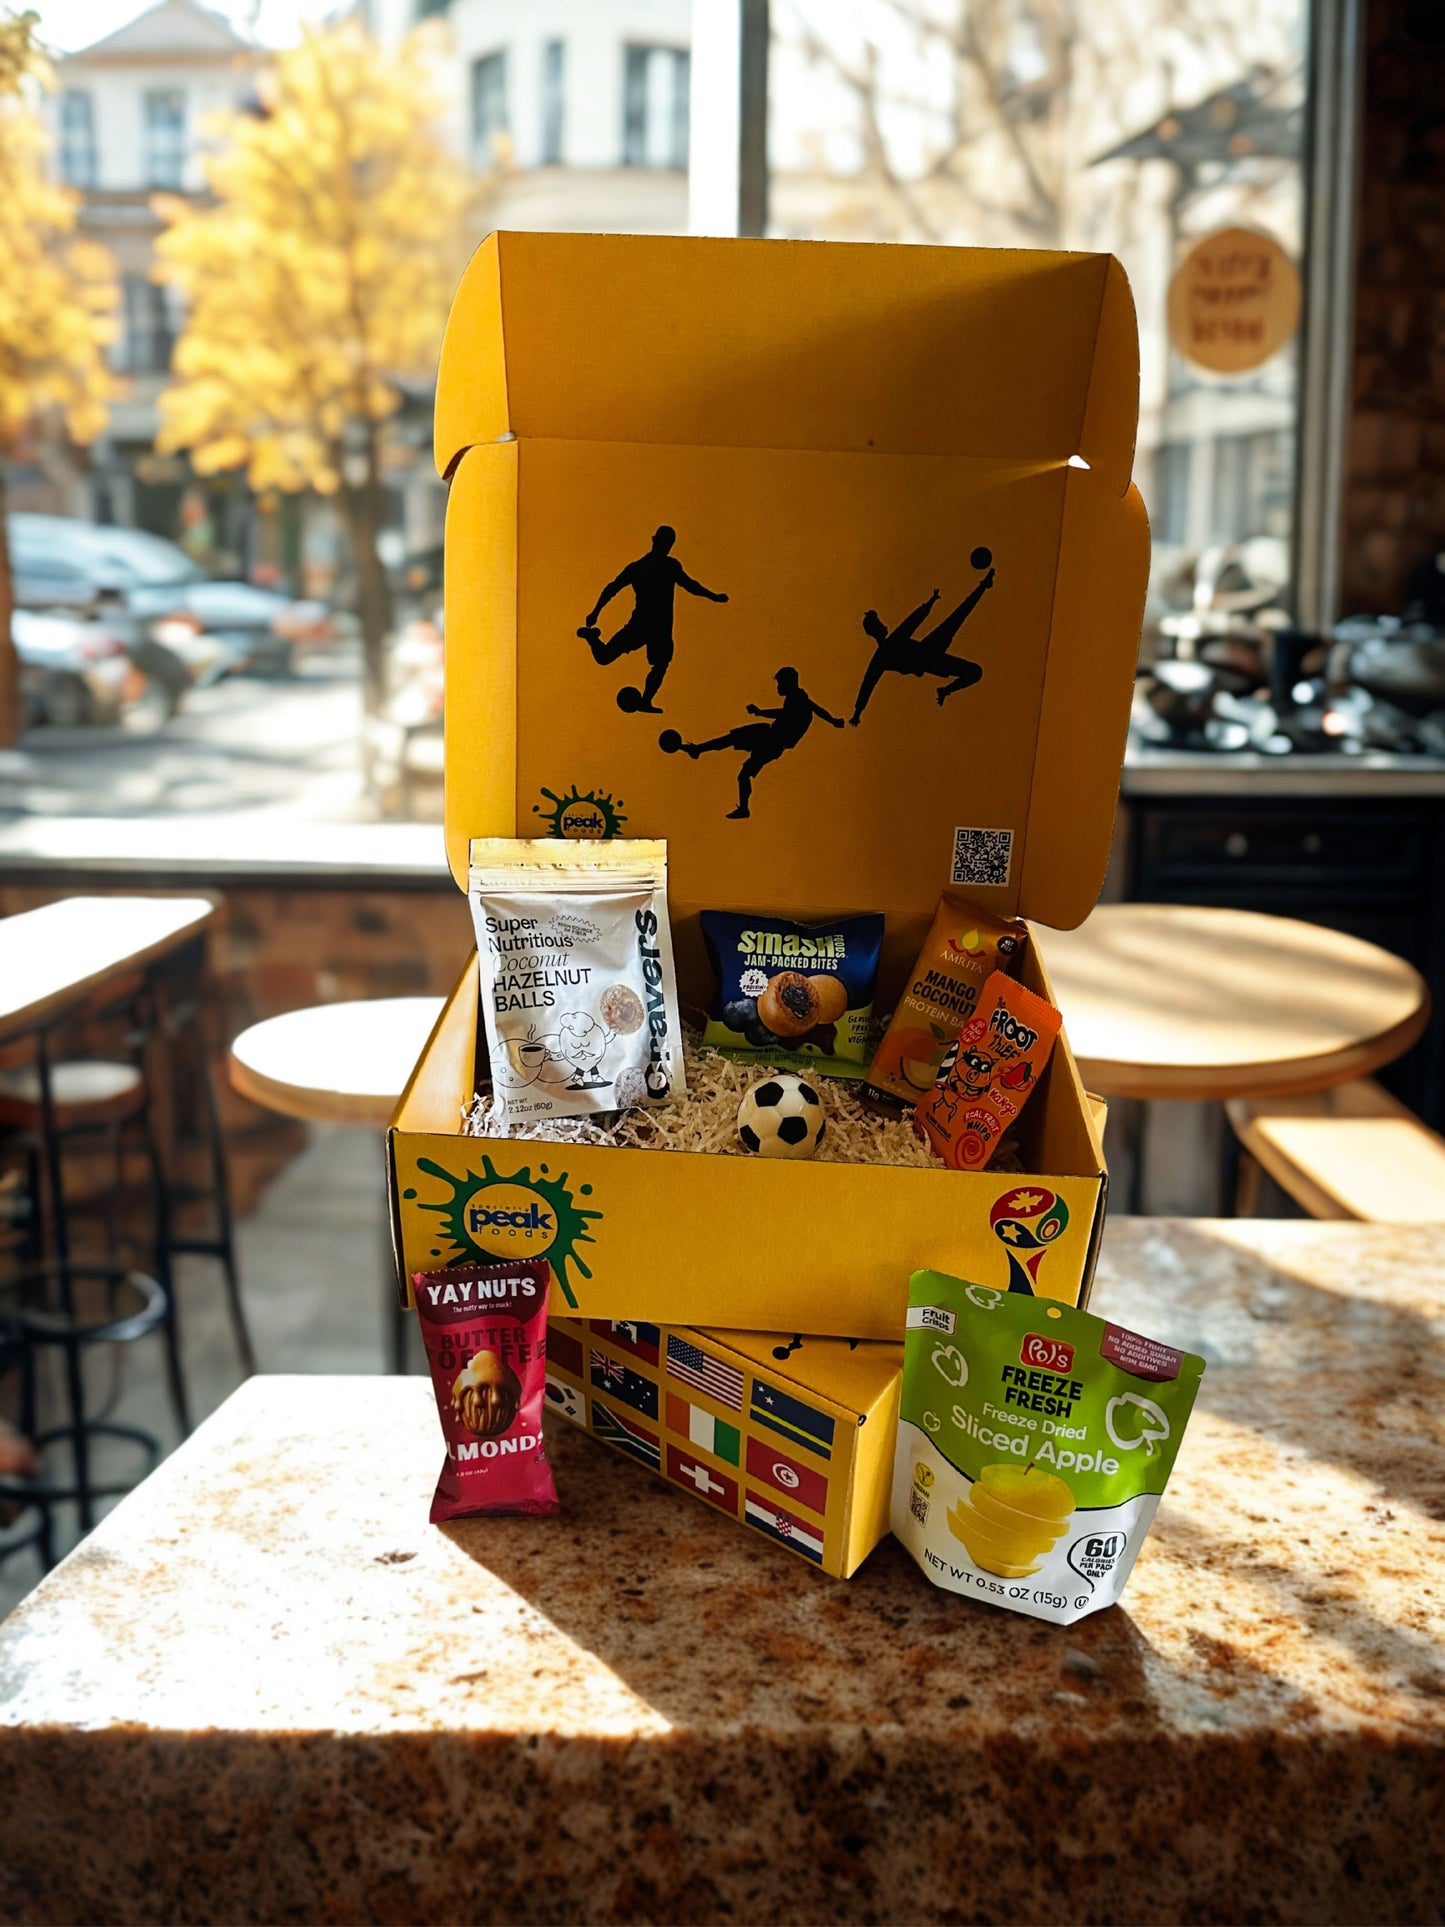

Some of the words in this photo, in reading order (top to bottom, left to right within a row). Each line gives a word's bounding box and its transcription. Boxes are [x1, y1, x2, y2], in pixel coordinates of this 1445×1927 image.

[564, 812, 604, 831] peak
[485, 917, 538, 935] Super
[488, 933, 574, 953] Nutritious
[833, 934, 845, 959] FOODS
[493, 952, 569, 972] Coconut
[744, 954, 809, 969] JAM-PACKED
[811, 957, 838, 970] BITES
[940, 950, 983, 973] AMRITA
[494, 968, 591, 992] HAZELNUT
[925, 969, 976, 1000] MANGO
[495, 990, 555, 1012] BALLS
[912, 981, 976, 1018] COCONUT
[904, 996, 950, 1022] PROTEIN
[950, 1016, 965, 1029] BA
[988, 1008, 1039, 1053] FROOT
[966, 1120, 991, 1141] WHIPS
[983, 1113, 999, 1132] FRUIT
[470, 1203, 554, 1233] peak
[478, 1225, 548, 1239] foods
[427, 1282, 473, 1305] YAY
[477, 1277, 536, 1299] NUTS
[463, 1305, 477, 1313] nutty
[922, 1309, 950, 1324] Fruit
[922, 1317, 949, 1331] Crisps
[440, 1327, 527, 1349] BUTTER
[1108, 1335, 1120, 1344] NO
[1121, 1340, 1148, 1354] ADDED
[1149, 1350, 1177, 1363] SUGAR
[1121, 1332, 1143, 1345] 100%
[1144, 1341, 1167, 1353] FRUIT
[438, 1338, 546, 1370] OFFEE
[1114, 1345, 1126, 1354] NO
[1126, 1350, 1168, 1367] ADDITIVES
[1119, 1355, 1137, 1366] NON
[1138, 1362, 1158, 1372] GMO
[1001, 1364, 1083, 1401] FREEZE
[1005, 1386, 1072, 1418] FRESH
[982, 1402, 1037, 1430] Freeze
[1041, 1419, 1087, 1440] Dried
[447, 1430, 543, 1461] LMOND
[951, 1404, 1030, 1457] Sliced
[1034, 1440, 1120, 1475] Apple
[1085, 1536, 1117, 1558] 60
[924, 1548, 947, 1571] NET
[949, 1566, 973, 1583] WT
[976, 1577, 1005, 1595] 0.53
[1008, 1587, 1030, 1600] OZ
[1033, 1590, 1067, 1609] (15g)
[1086, 1569, 1106, 1578] ONLY
